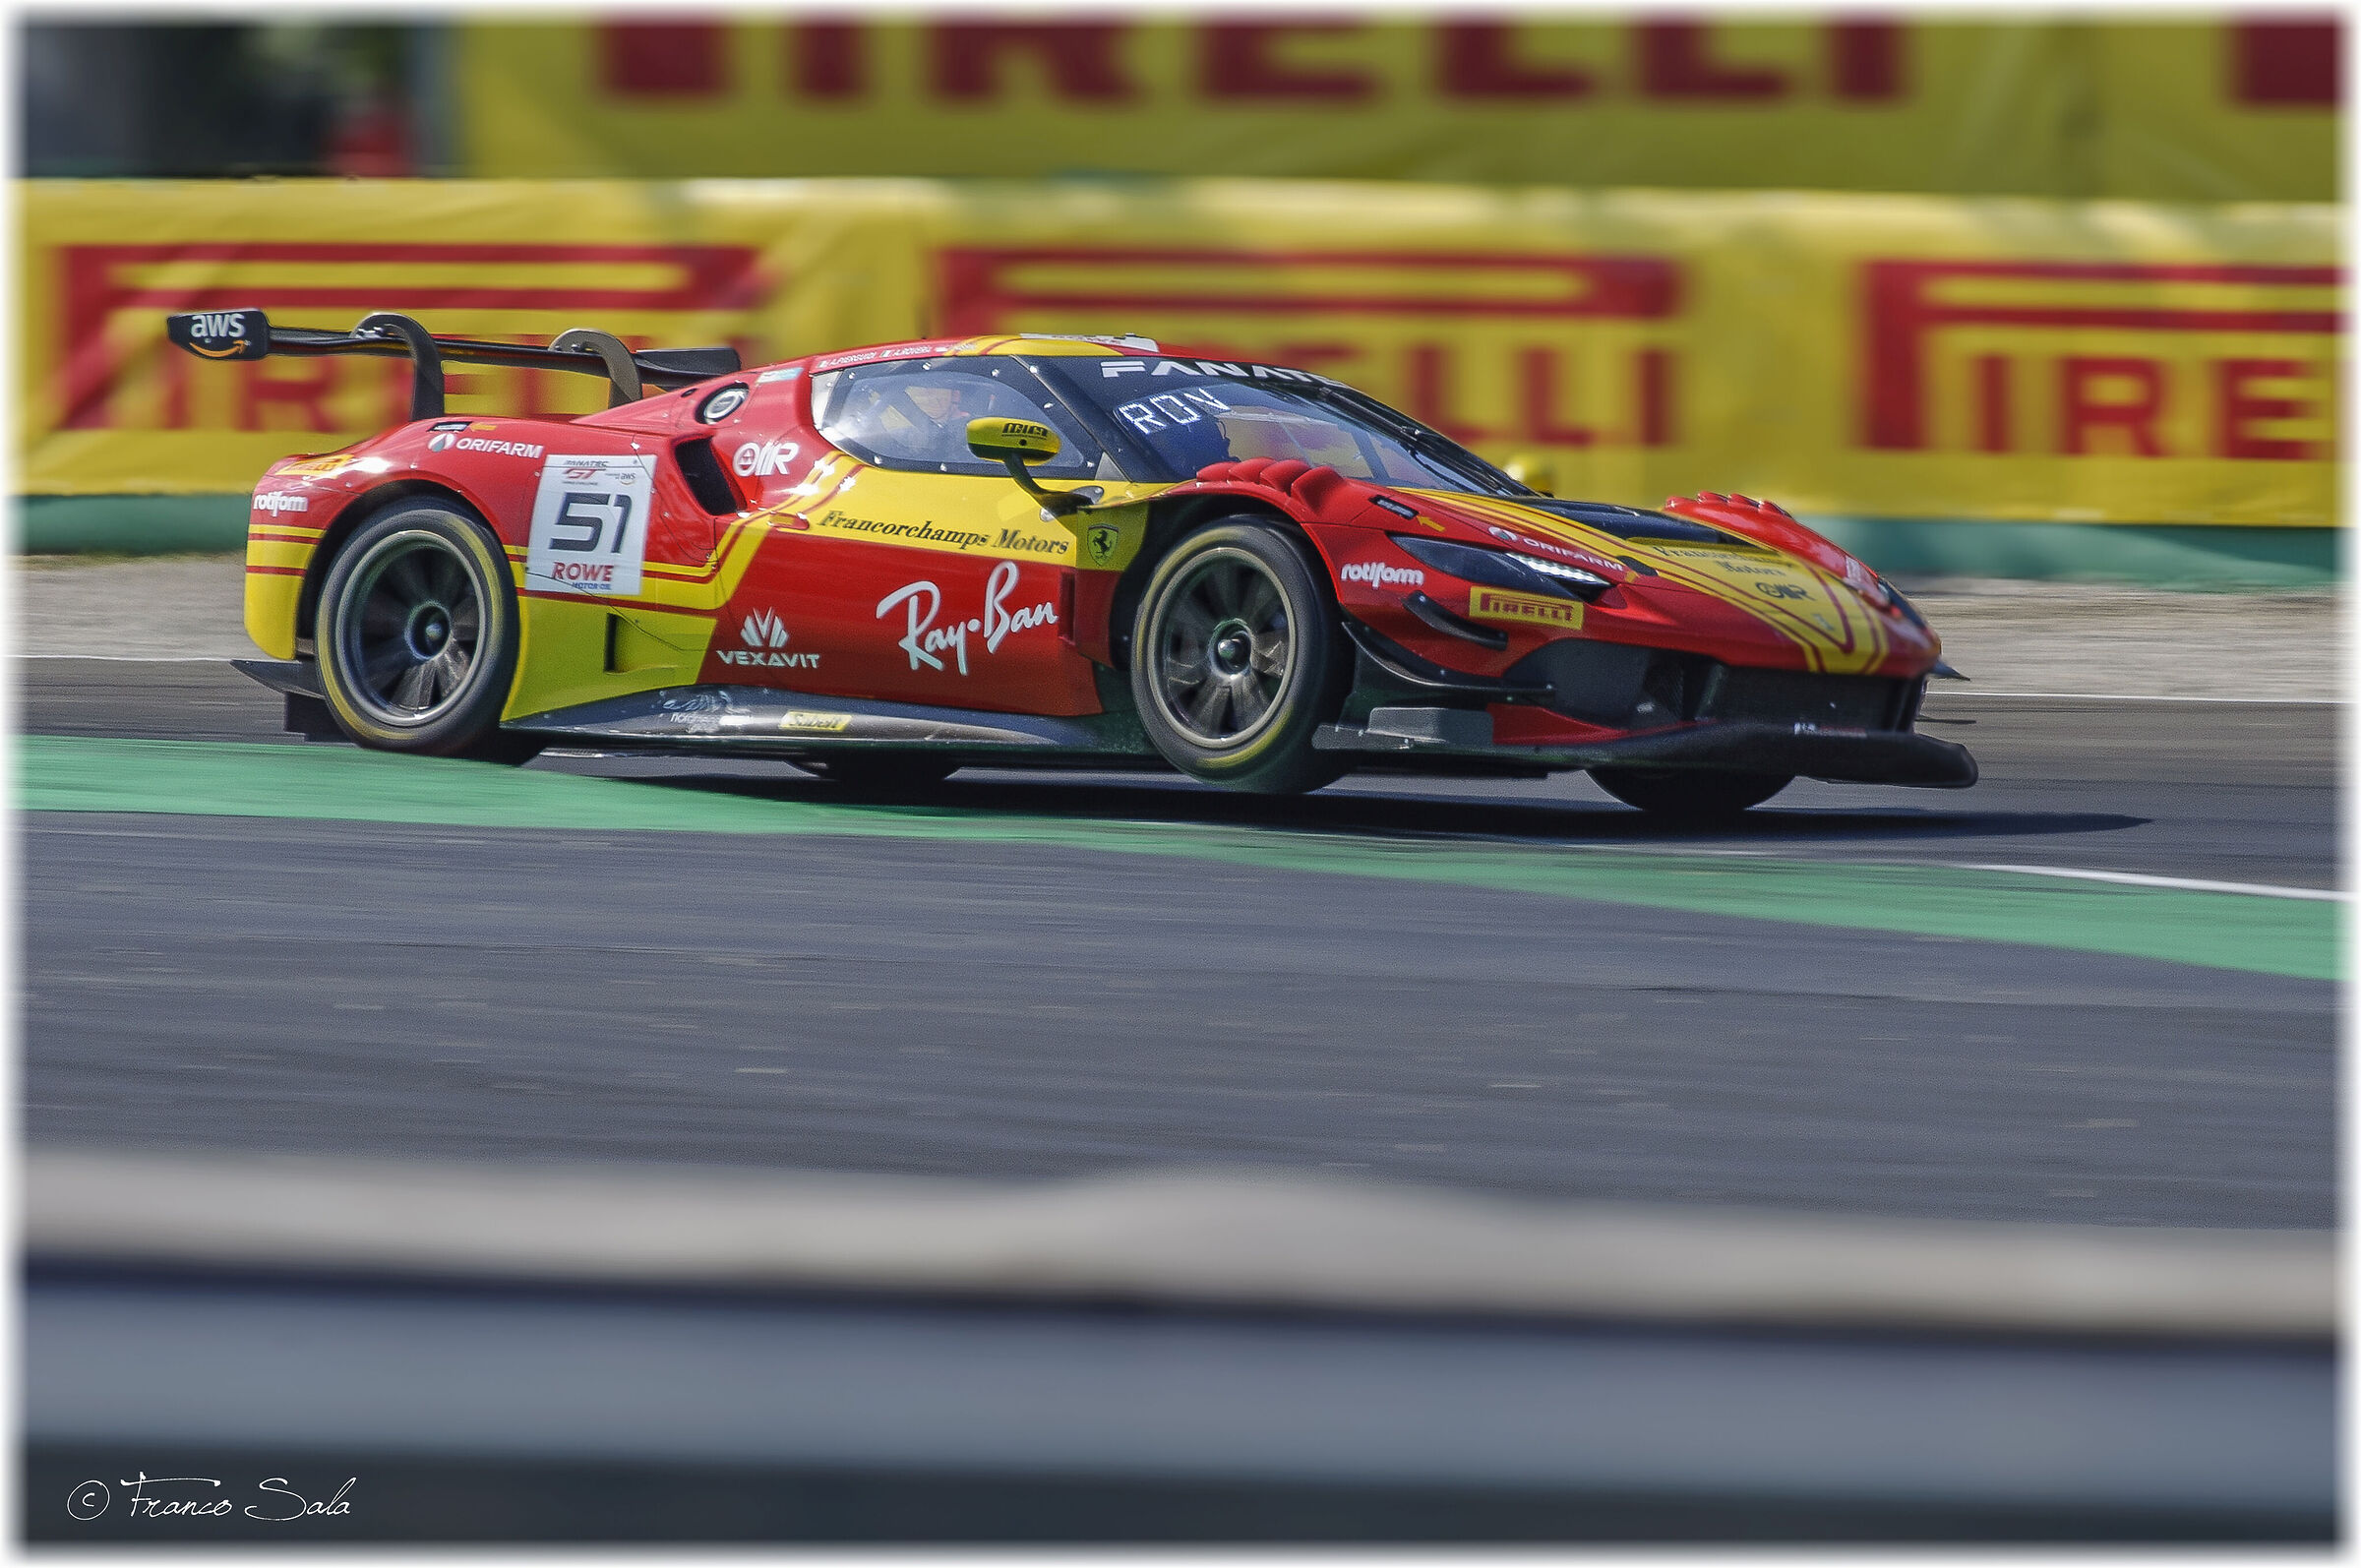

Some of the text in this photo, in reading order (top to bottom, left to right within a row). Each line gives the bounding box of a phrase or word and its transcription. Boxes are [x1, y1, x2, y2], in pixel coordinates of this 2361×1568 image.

[191, 313, 246, 337] aws
[1100, 360, 1349, 390] FANATE
[455, 437, 544, 458] ORIFARM
[549, 492, 633, 554] 51
[817, 510, 1069, 555] Francorchamps Motors
[1523, 538, 1623, 572] ORIFARM
[552, 562, 614, 582] ROWE
[716, 650, 820, 669] VEXAVIT
